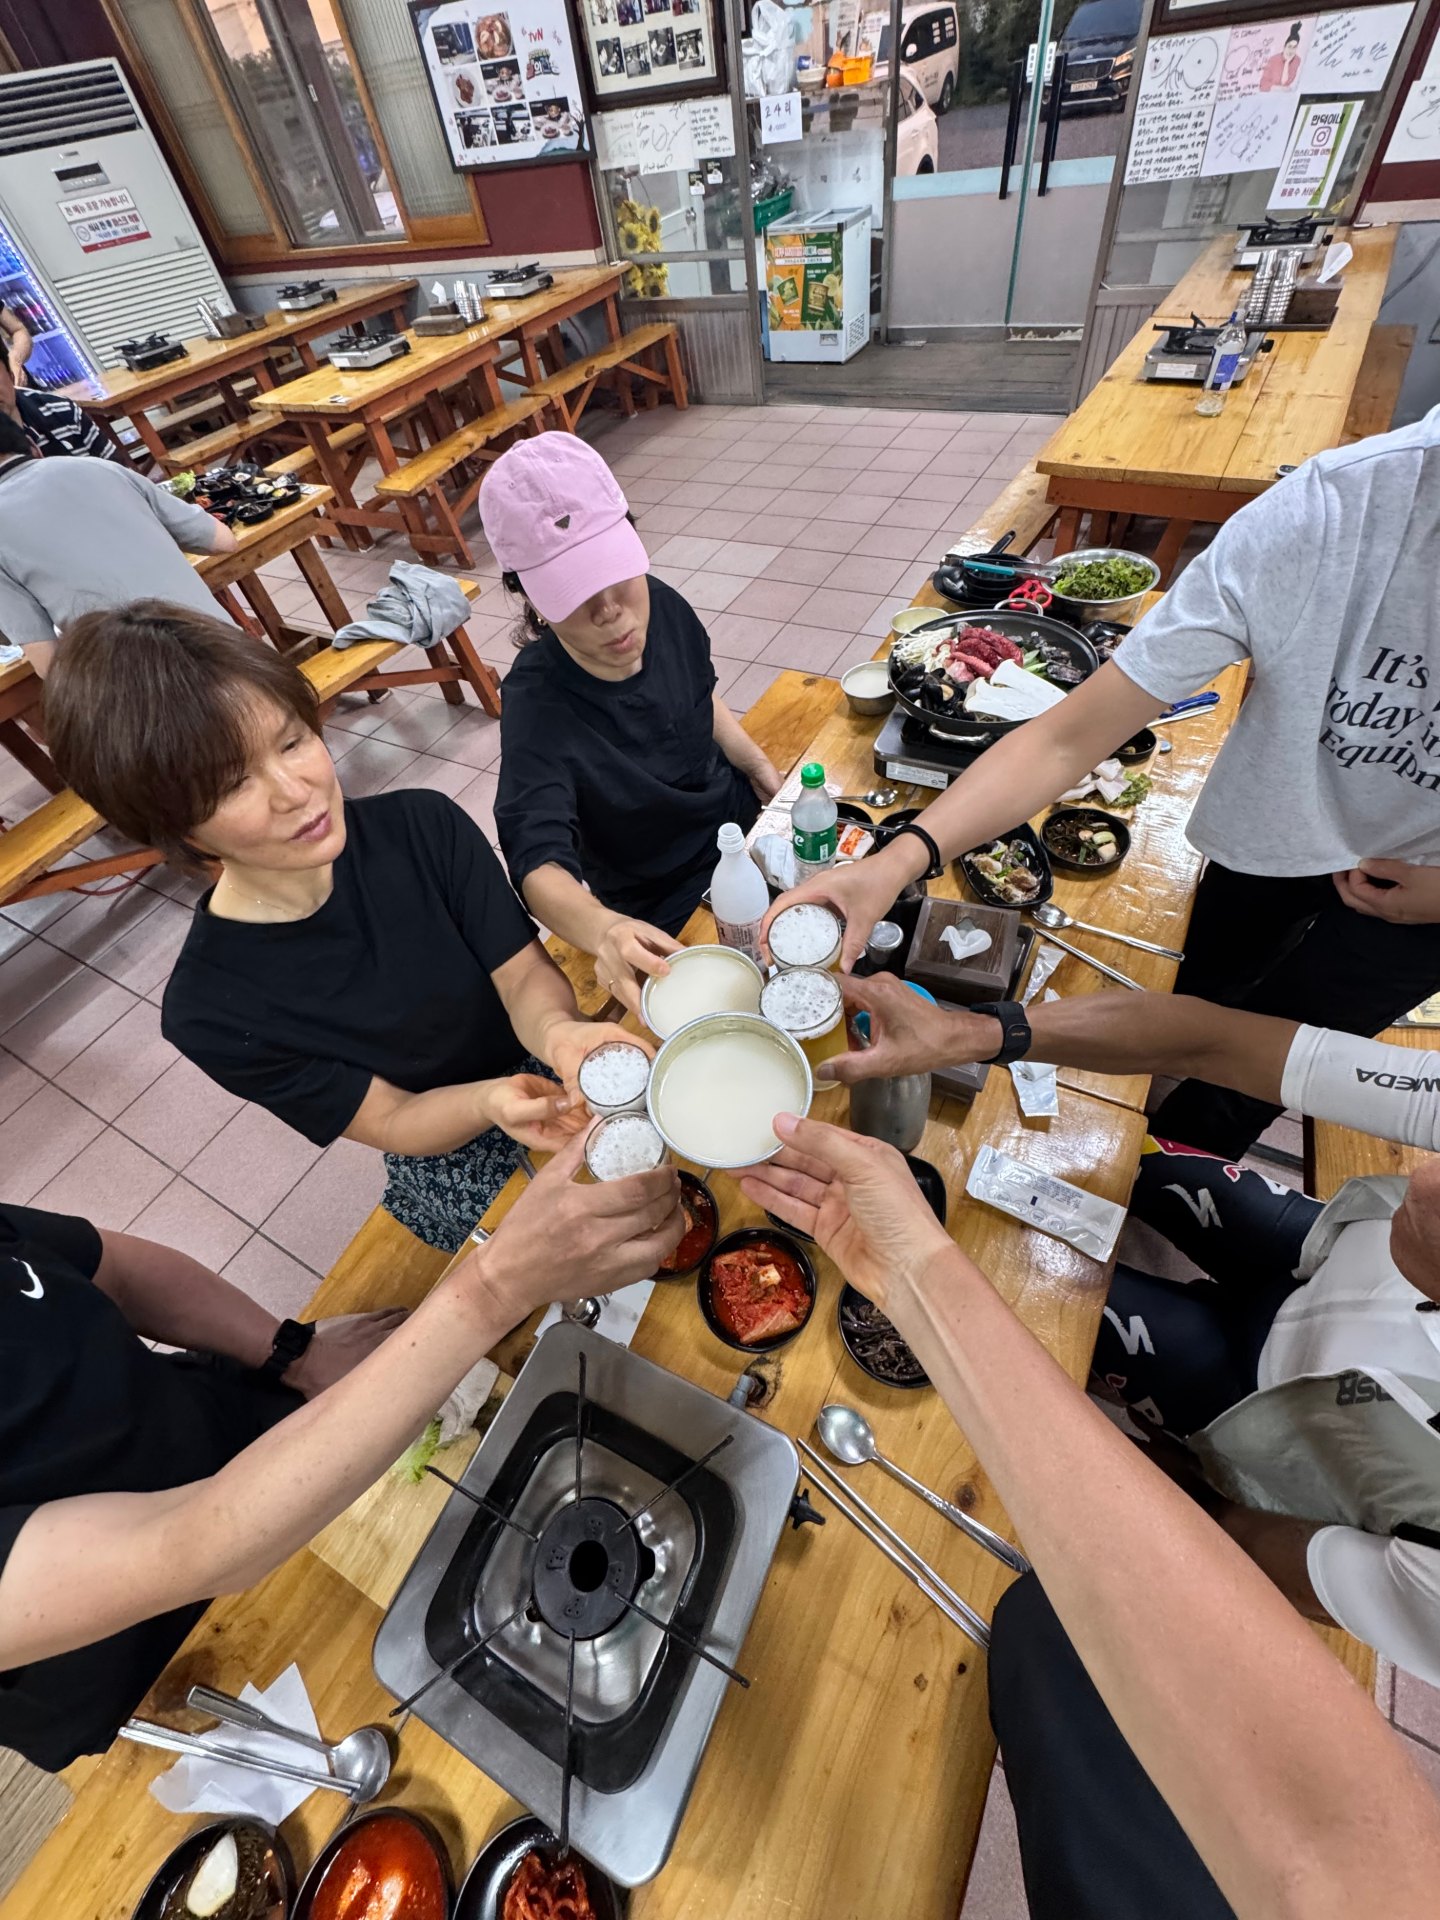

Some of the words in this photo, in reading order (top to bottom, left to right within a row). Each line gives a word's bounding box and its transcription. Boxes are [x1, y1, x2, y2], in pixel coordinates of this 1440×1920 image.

[1310, 113, 1346, 126] 만덕이네
[1280, 188, 1300, 197] 음료수
[99, 194, 128, 207] 가능합니다
[1361, 646, 1430, 689] It's
[1326, 677, 1424, 739] Today
